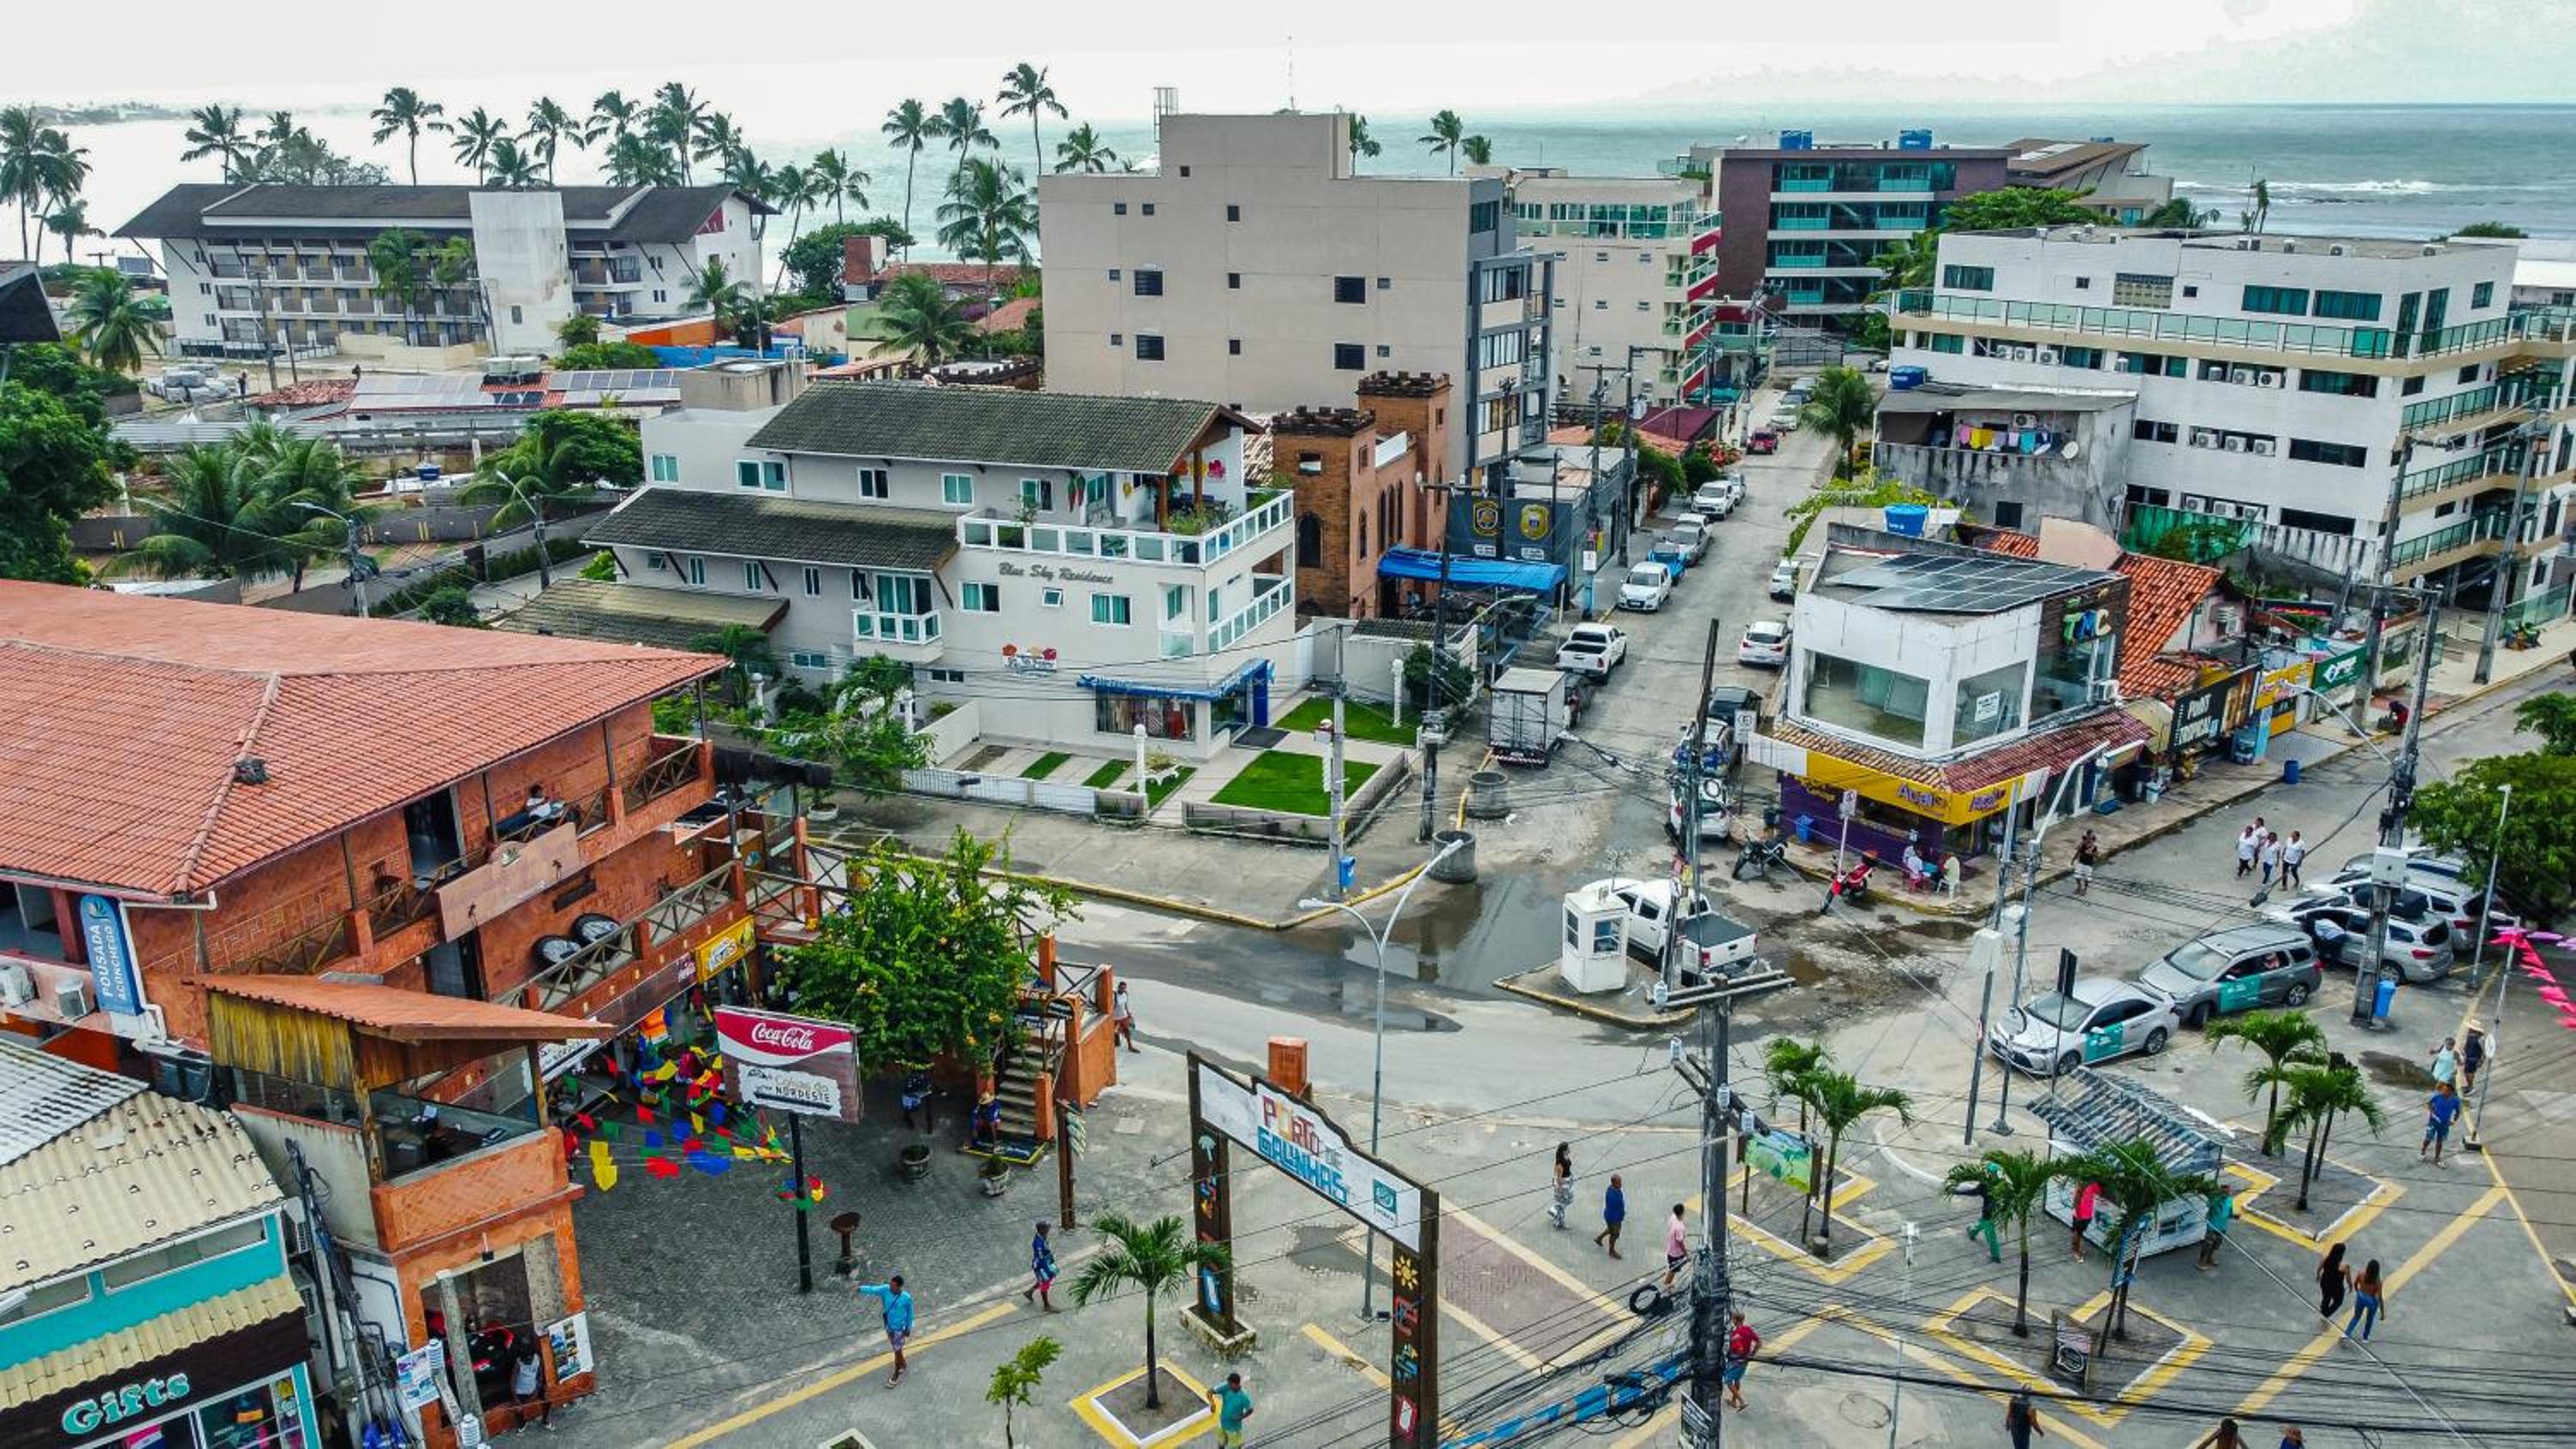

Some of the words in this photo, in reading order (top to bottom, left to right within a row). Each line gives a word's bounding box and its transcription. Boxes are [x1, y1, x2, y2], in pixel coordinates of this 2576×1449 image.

[999, 561, 1024, 576] Blue
[1030, 564, 1054, 581] Sky
[1058, 567, 1114, 584] Residence
[90, 925, 113, 997] POUSADA
[751, 1022, 816, 1051] Coca-Cola
[775, 1085, 831, 1103] NORDESTE
[1263, 1094, 1320, 1157] PORTO
[61, 1372, 191, 1434] Gifts
